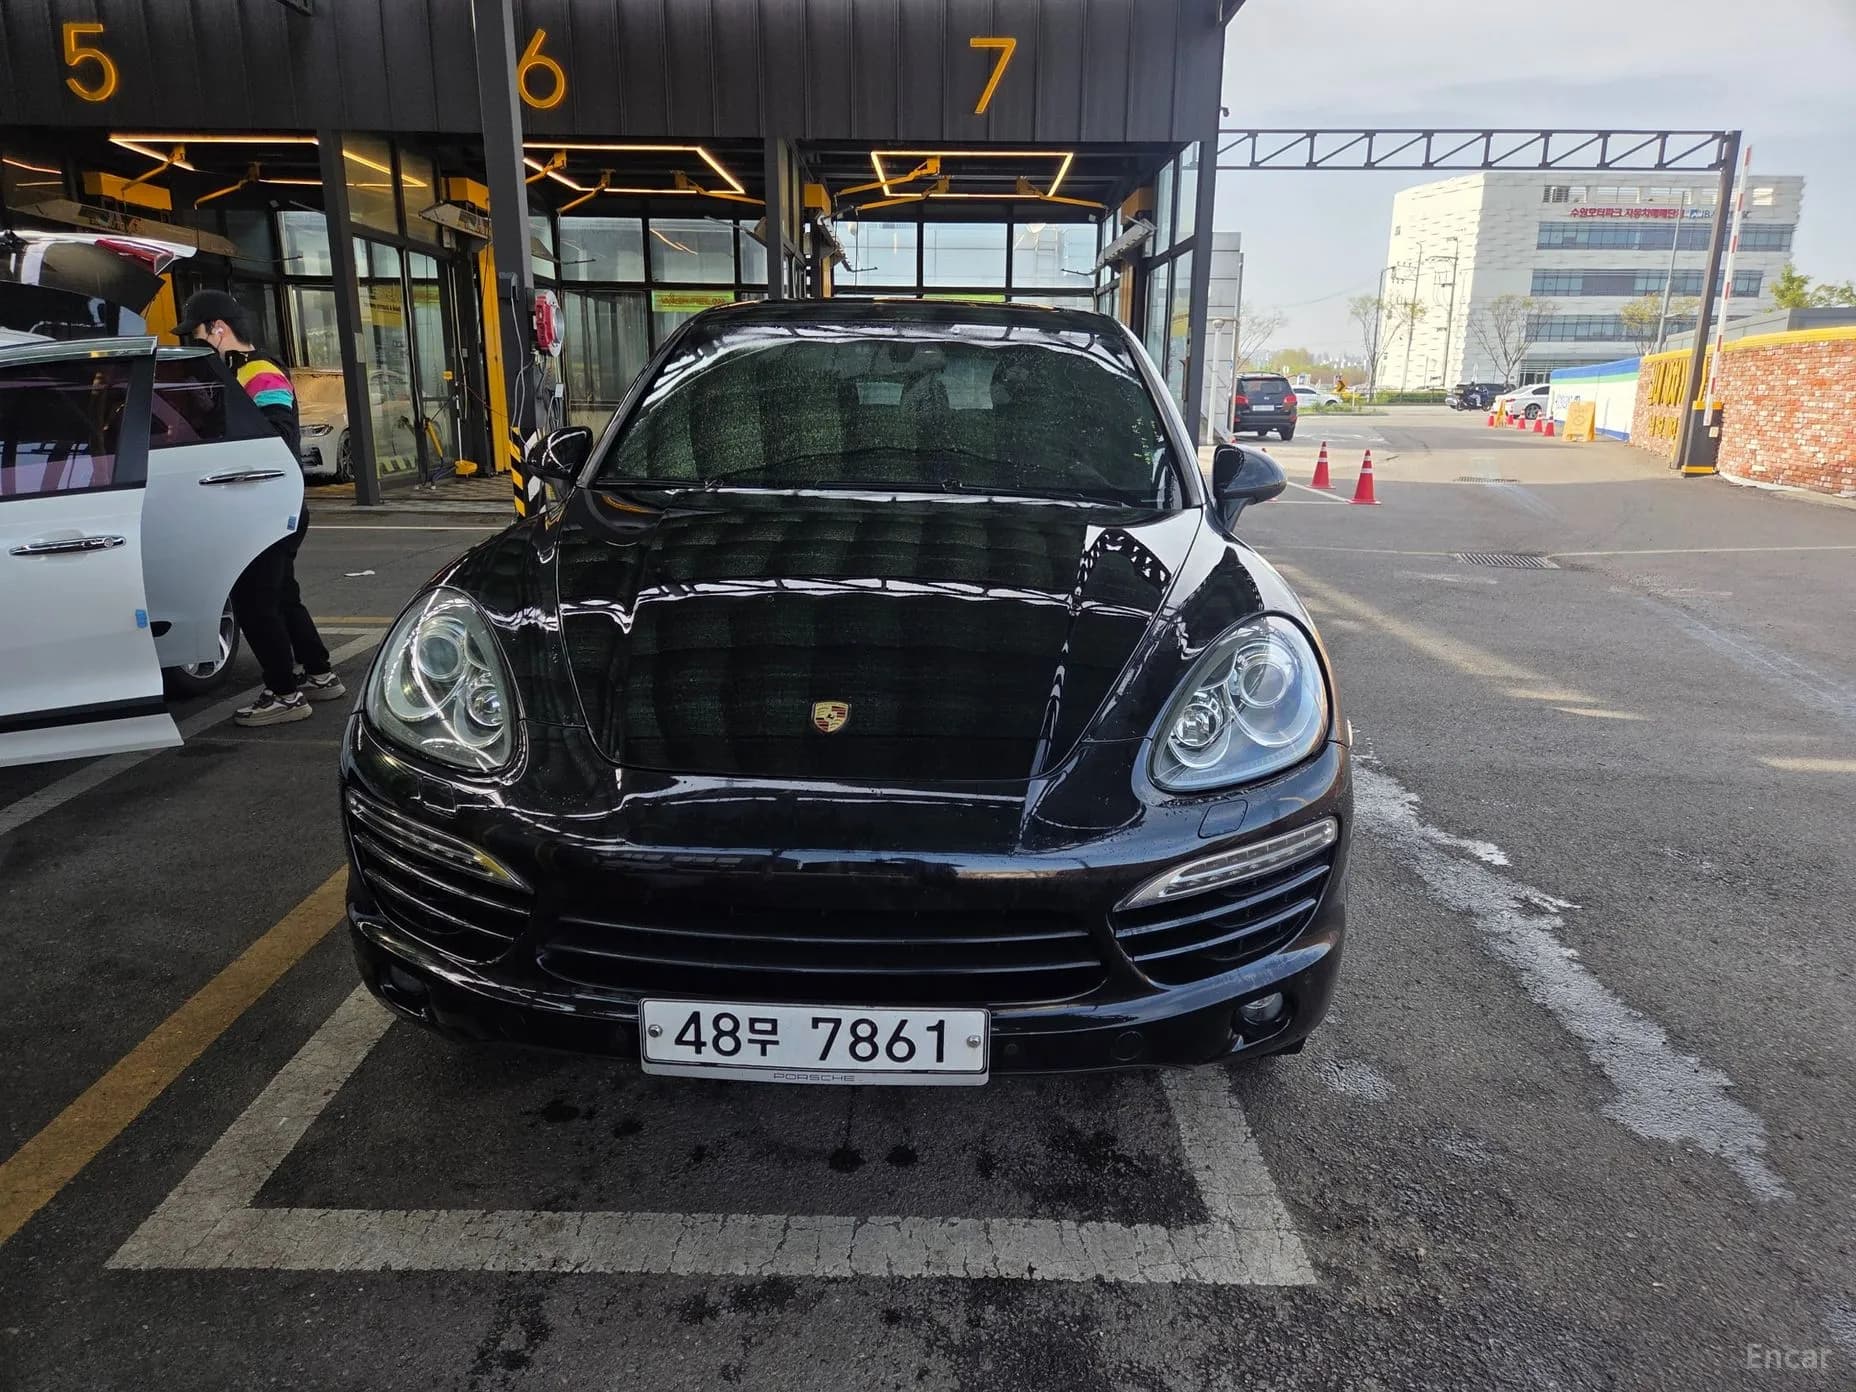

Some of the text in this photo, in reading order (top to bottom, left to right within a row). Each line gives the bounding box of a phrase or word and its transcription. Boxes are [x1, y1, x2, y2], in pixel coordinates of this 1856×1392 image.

[63, 23, 116, 101] 5
[517, 28, 565, 109] 6
[970, 37, 1017, 114] 7
[1569, 207, 1623, 219] 수원모터파크
[673, 1010, 946, 1064] 48무 7861
[773, 1071, 856, 1082] PORSCHE
